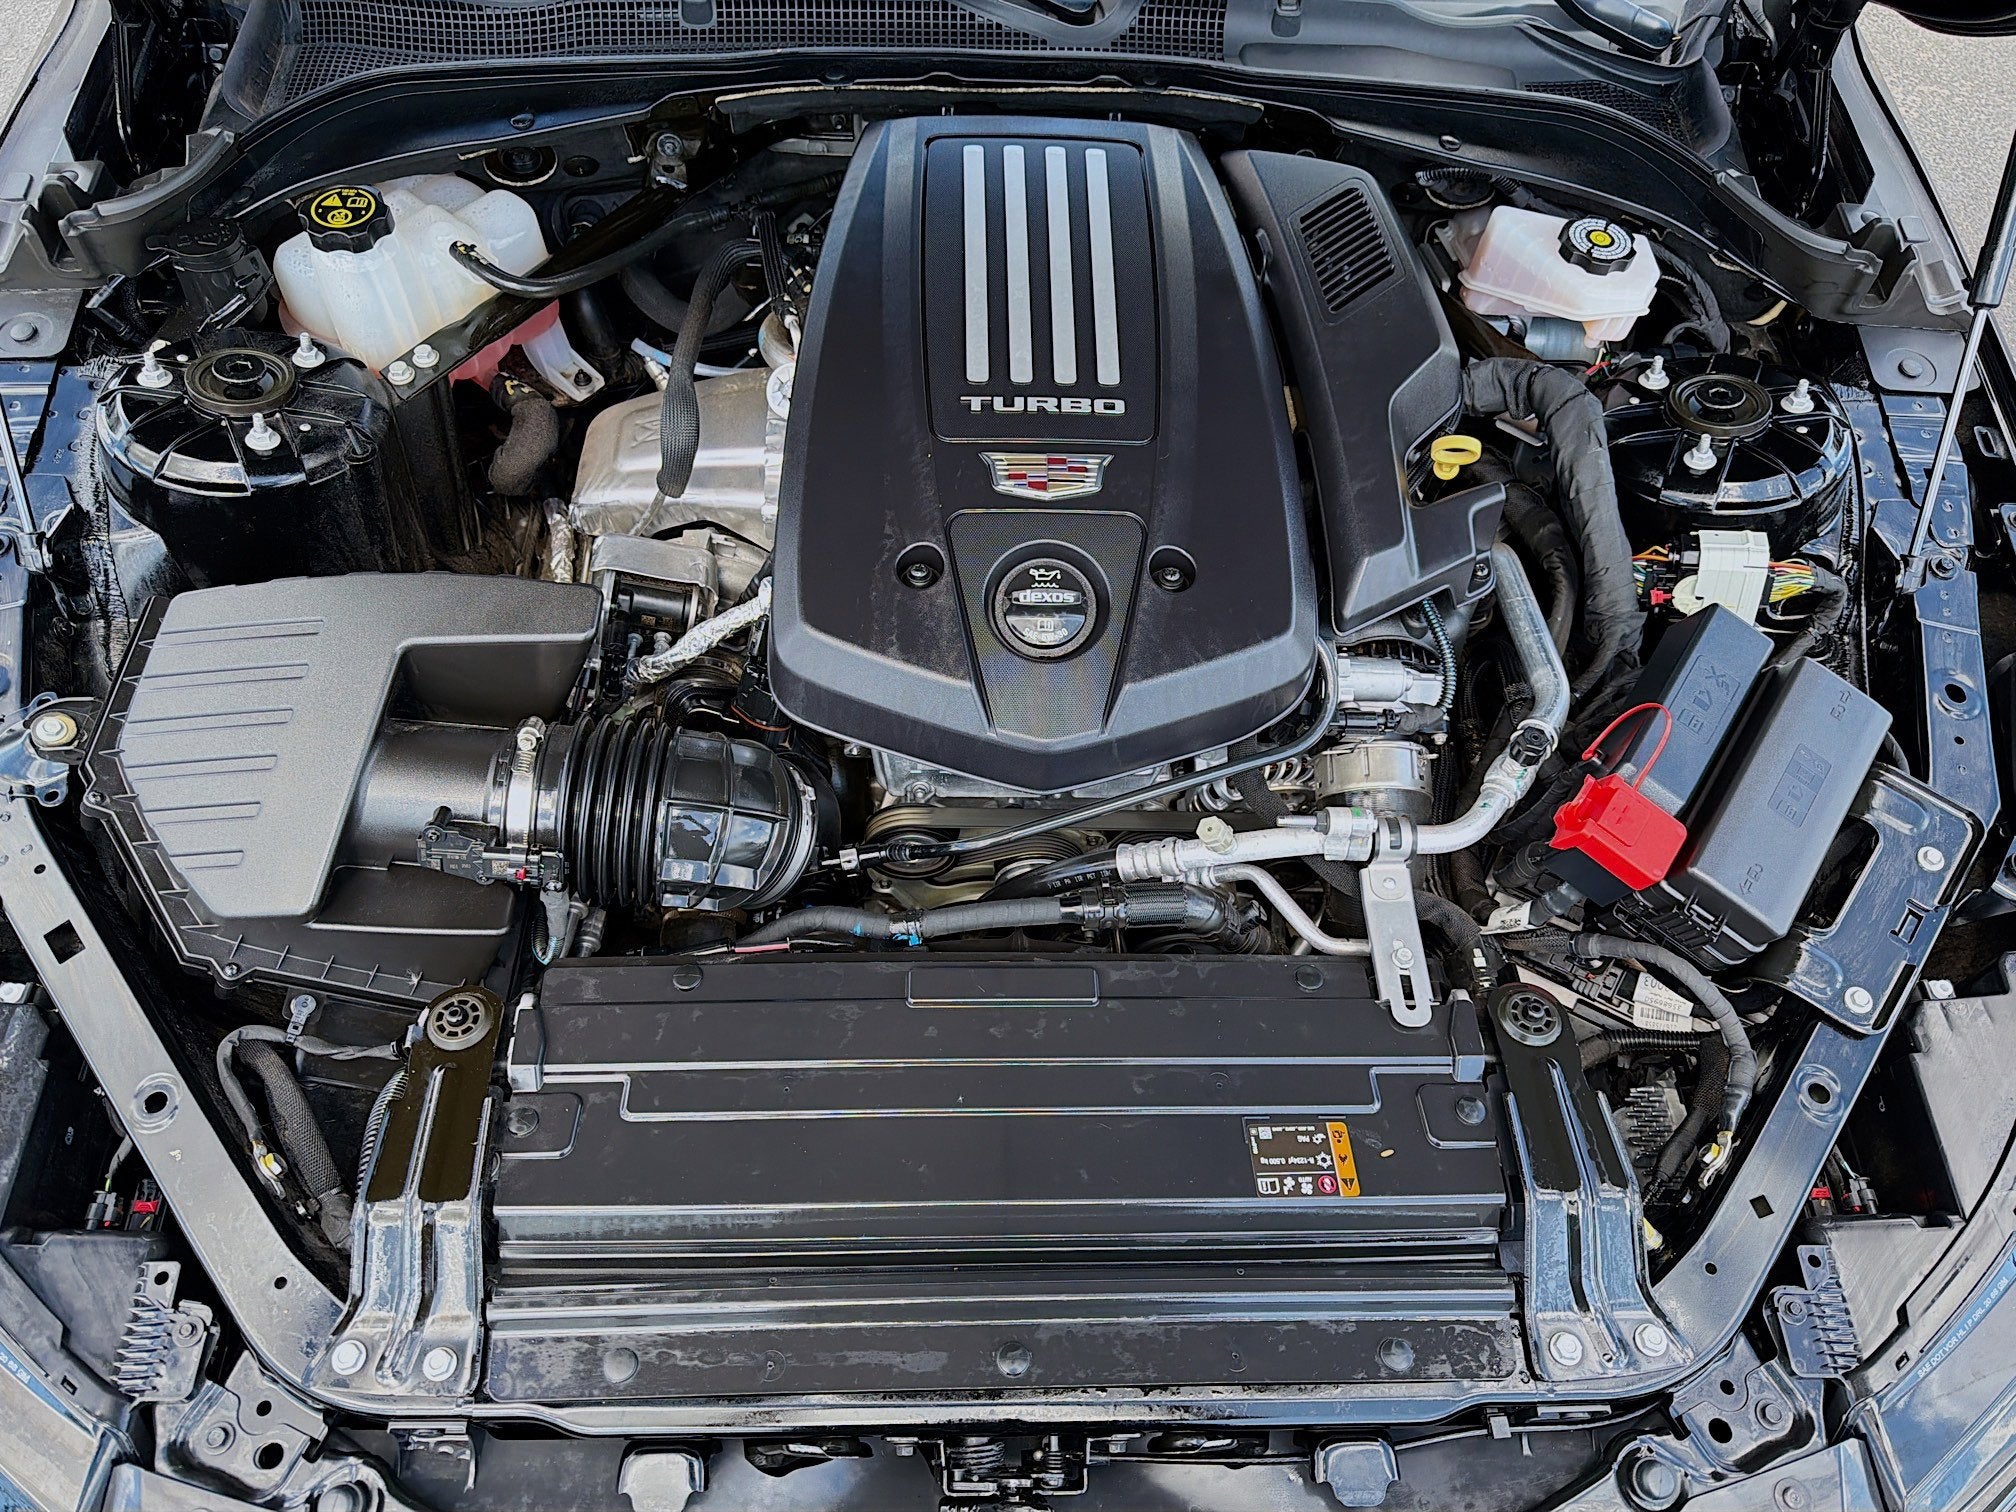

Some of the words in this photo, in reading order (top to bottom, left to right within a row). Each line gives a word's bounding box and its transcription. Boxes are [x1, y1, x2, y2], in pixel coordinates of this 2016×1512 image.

[960, 395, 1126, 415] TURBO
[1018, 589, 1075, 603] dexos
[1917, 1362, 1931, 1379] SAE
[1930, 1349, 1945, 1367] DOT
[1943, 1337, 1959, 1352] VOR
